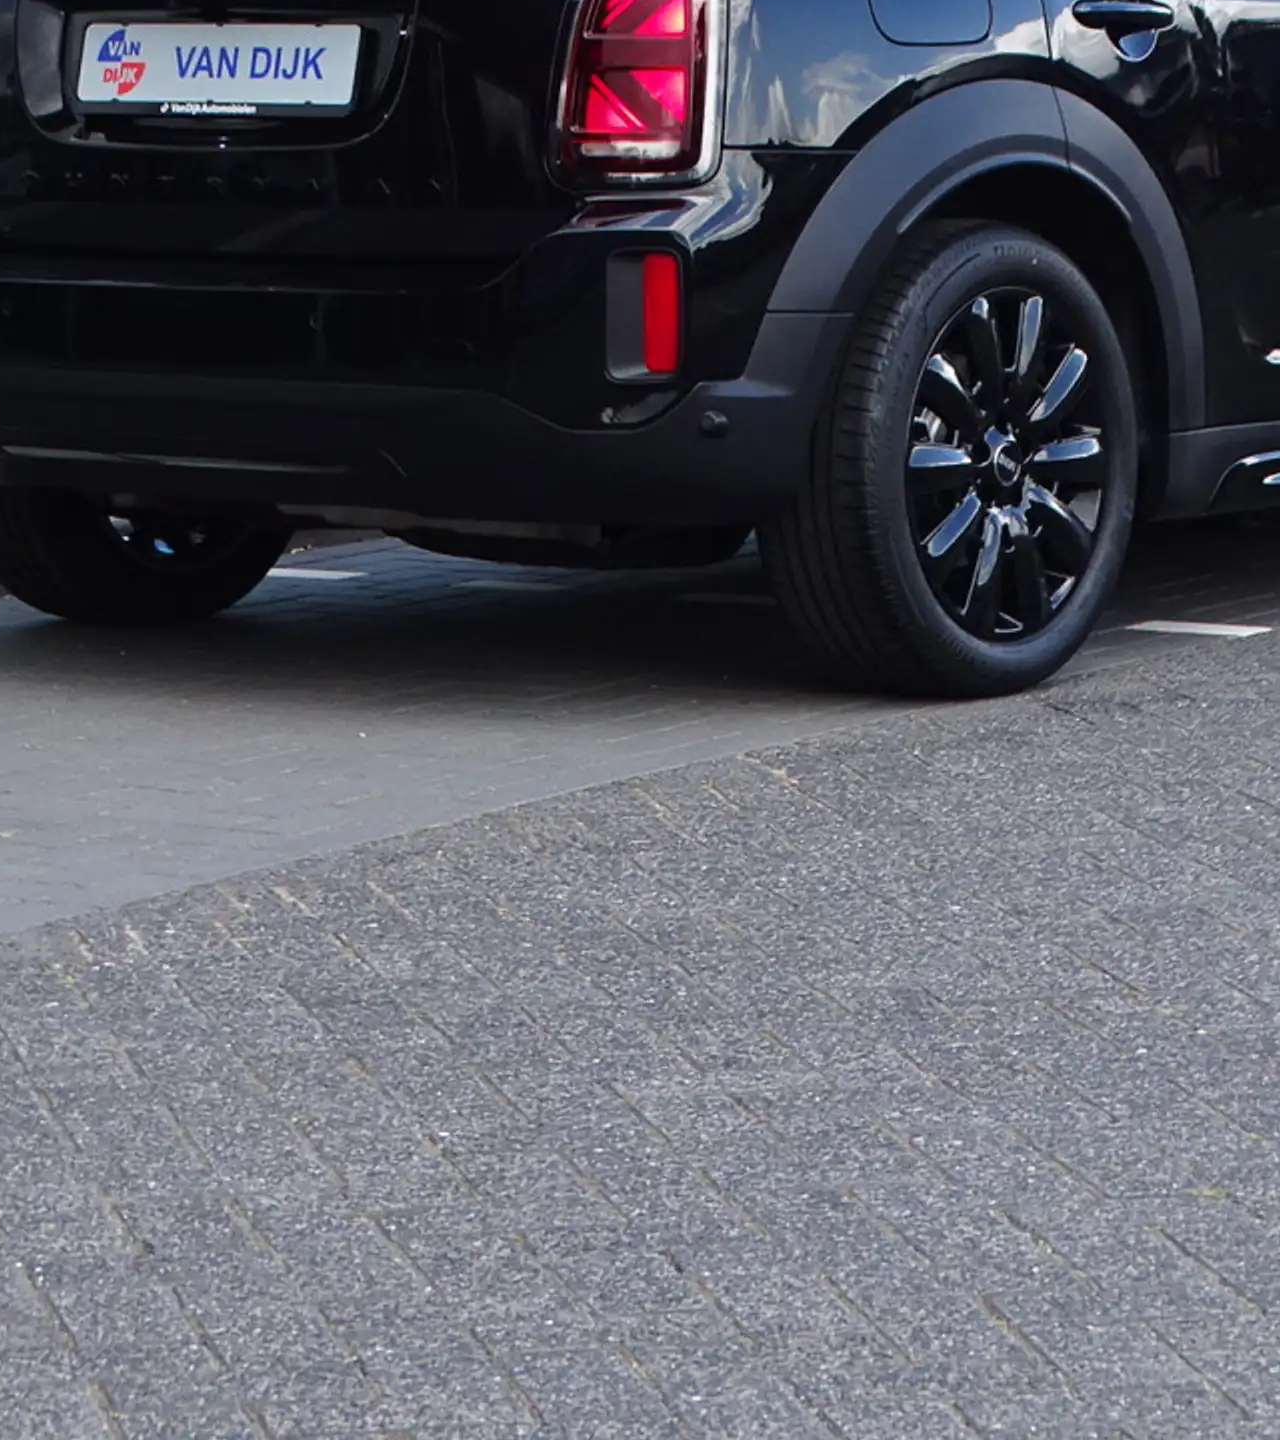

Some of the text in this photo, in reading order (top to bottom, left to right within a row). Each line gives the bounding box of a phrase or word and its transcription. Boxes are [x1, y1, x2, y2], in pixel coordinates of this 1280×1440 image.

[107, 39, 141, 57] VAN
[175, 45, 327, 80] VAN DIJK
[103, 66, 138, 84] DIJK
